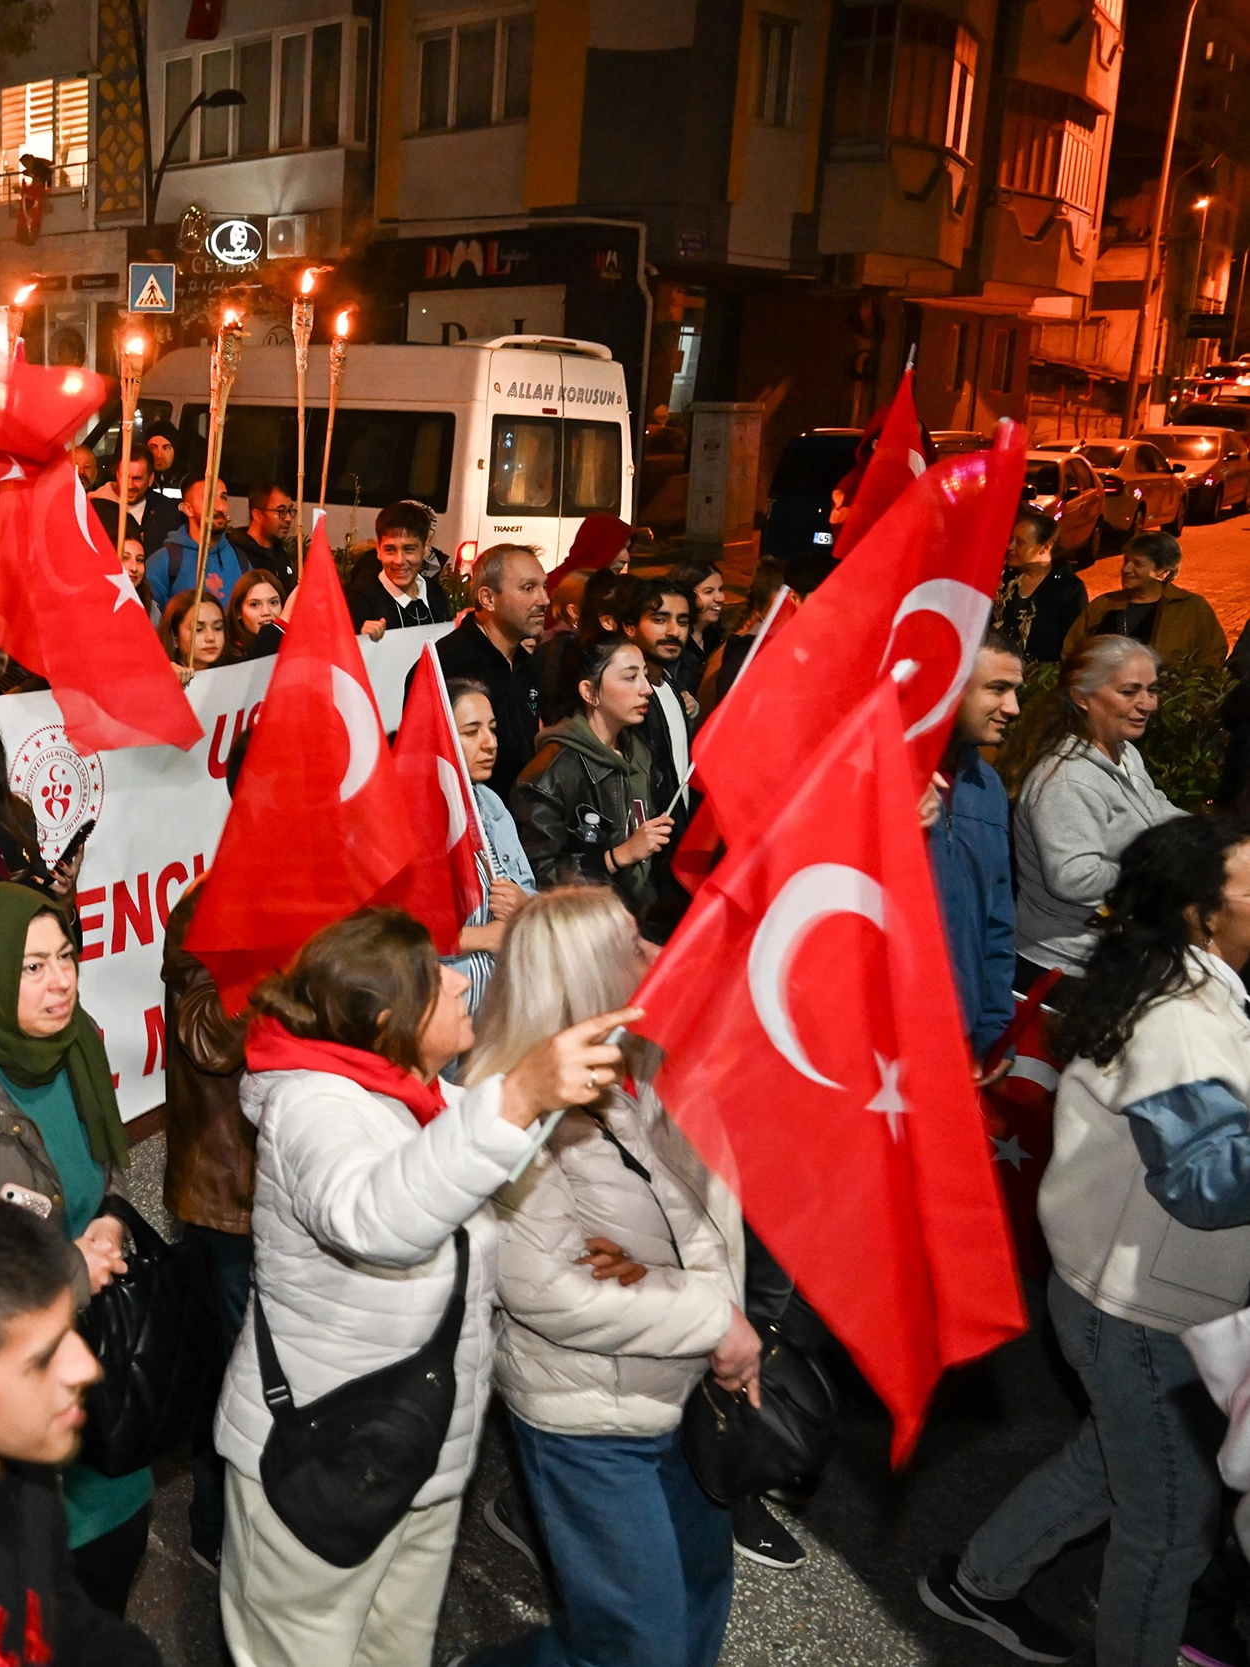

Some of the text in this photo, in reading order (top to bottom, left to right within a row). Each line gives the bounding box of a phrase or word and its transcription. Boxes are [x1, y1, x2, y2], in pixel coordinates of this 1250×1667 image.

[507, 381, 616, 406] ALLAH KORUSUN
[493, 525, 523, 533] TRANSIT
